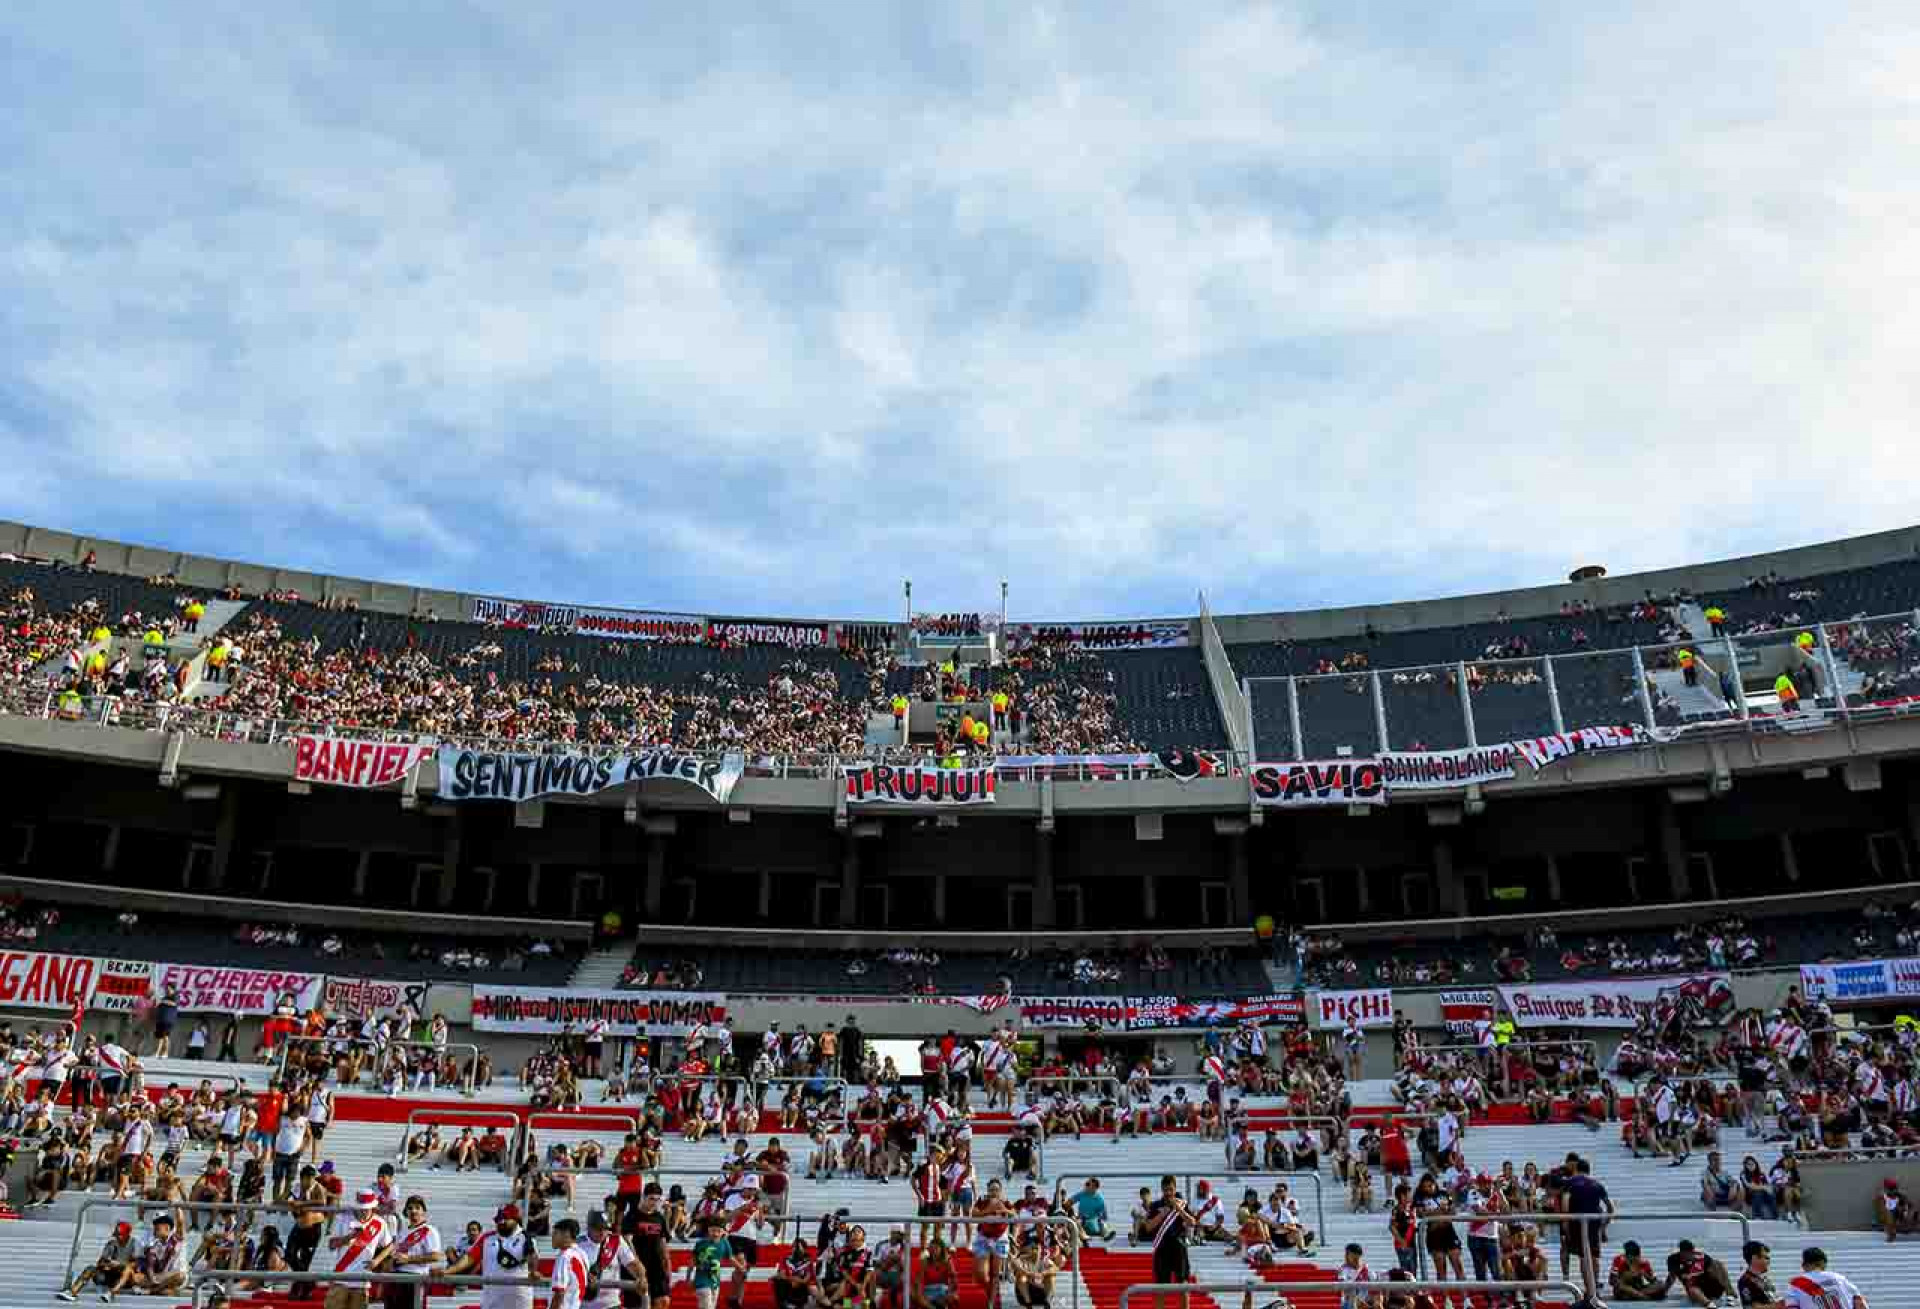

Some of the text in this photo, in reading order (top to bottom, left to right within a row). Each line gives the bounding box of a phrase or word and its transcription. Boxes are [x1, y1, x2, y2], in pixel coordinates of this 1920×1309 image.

[1083, 625, 1145, 649] VARELA
[453, 750, 722, 798] SENTIMOS RIVER
[1384, 748, 1513, 785] BAHIA BLANCA
[1256, 764, 1384, 799] SAVIO
[0, 953, 94, 1004] GANO
[107, 960, 150, 974] BENJA
[161, 966, 317, 994] ETCHEVERRY
[195, 990, 215, 1007] DE
[483, 995, 524, 1021] MIRA
[1512, 993, 1586, 1021] Amigos
